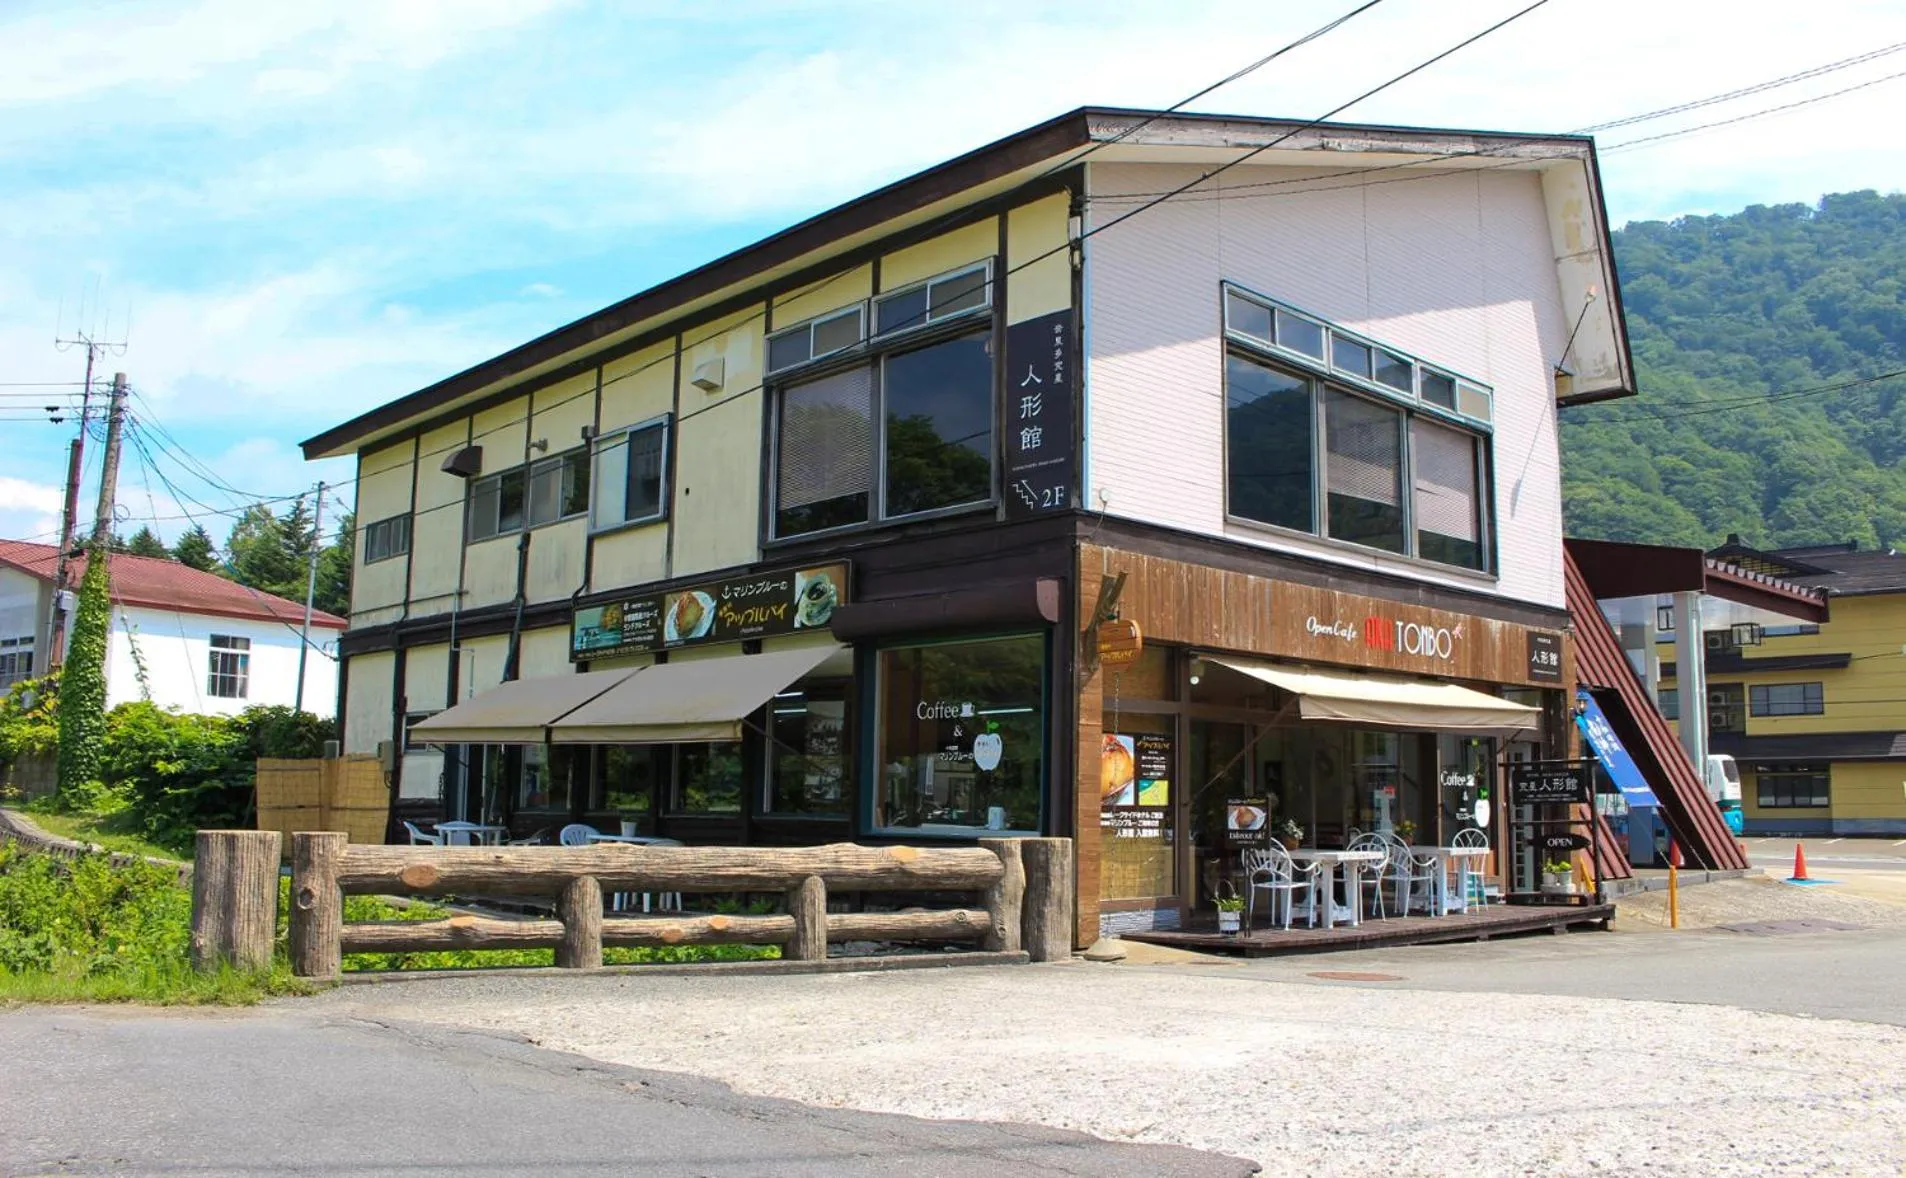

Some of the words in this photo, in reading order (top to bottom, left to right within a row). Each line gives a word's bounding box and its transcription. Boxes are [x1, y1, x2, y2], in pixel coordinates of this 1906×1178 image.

[1020, 363, 1043, 451] 人形館
[1041, 485, 1065, 508] 2F
[916, 700, 960, 720] Coffee
[953, 724, 963, 737] &
[1440, 770, 1466, 786] Coffee
[1546, 837, 1573, 847] OPEN
